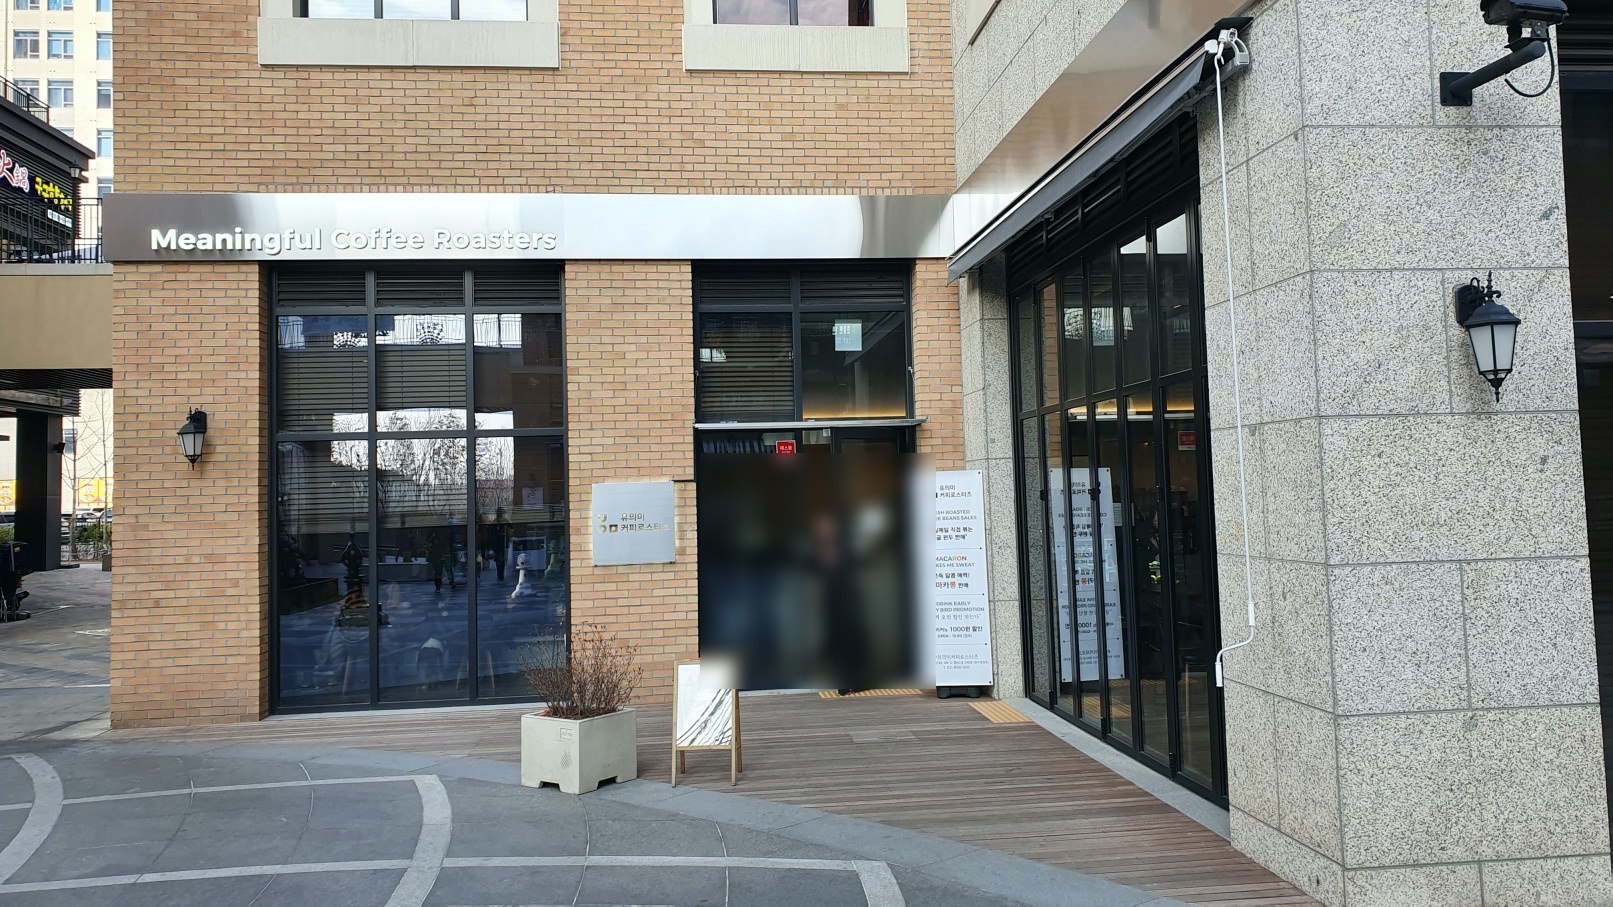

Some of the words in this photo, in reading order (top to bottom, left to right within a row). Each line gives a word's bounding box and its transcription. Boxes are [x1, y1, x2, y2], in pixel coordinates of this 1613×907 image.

[151, 227, 322, 255] Meaningful
[330, 228, 425, 250] Coffee
[433, 228, 557, 250] Roasters
[620, 513, 645, 522] 유의미
[620, 523, 670, 533] 커피로스터즈
[950, 625, 971, 633] 1000원
